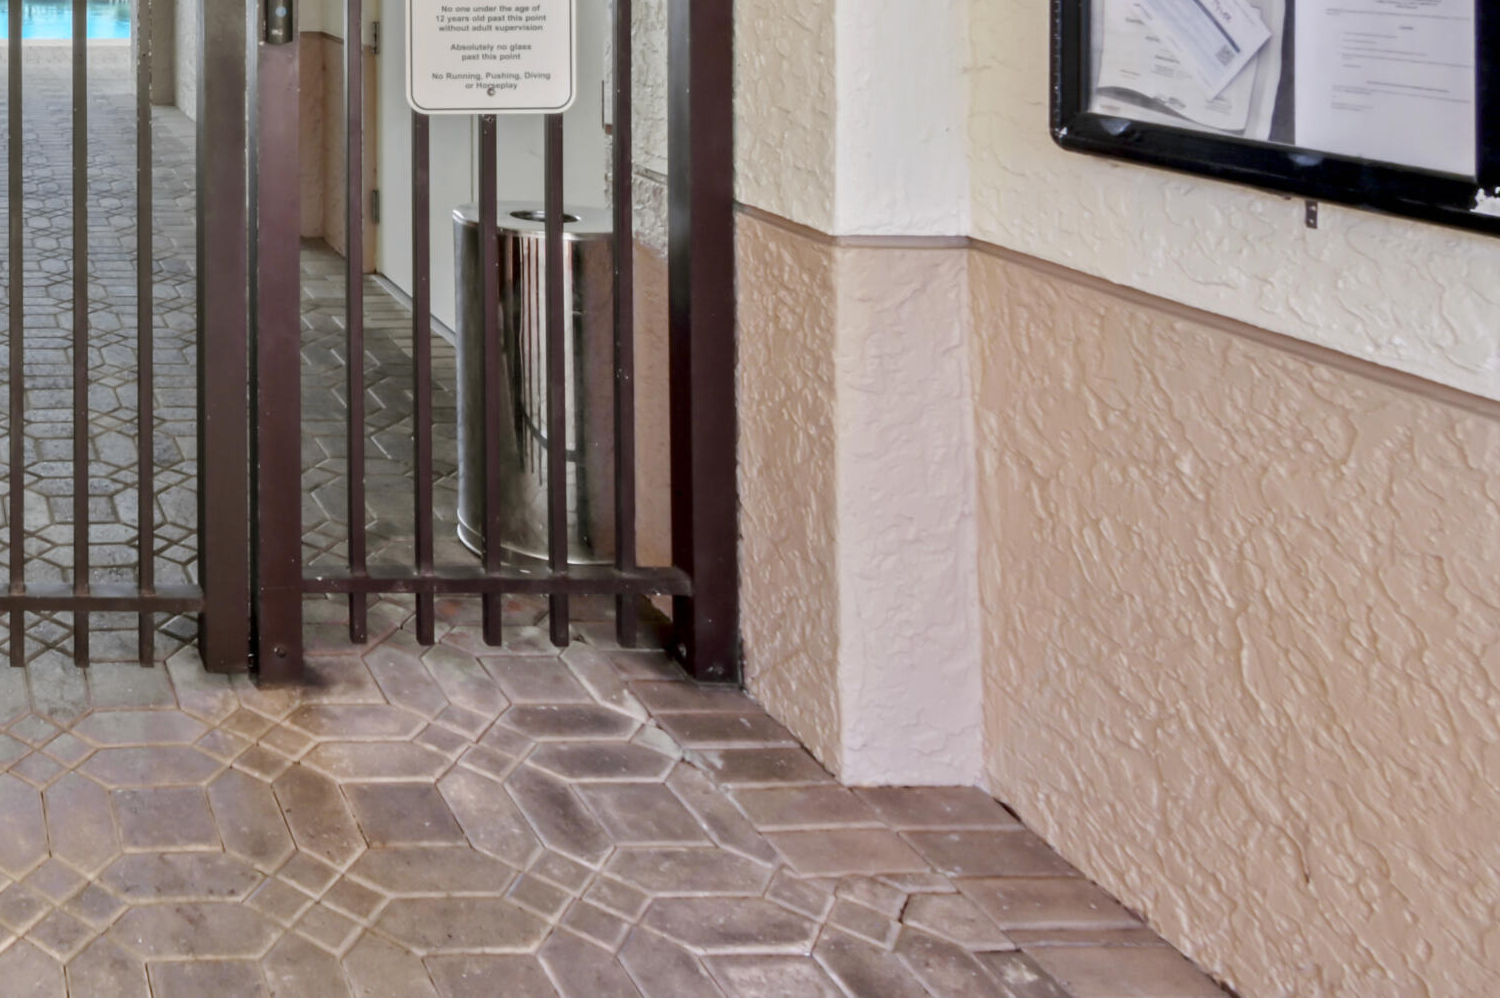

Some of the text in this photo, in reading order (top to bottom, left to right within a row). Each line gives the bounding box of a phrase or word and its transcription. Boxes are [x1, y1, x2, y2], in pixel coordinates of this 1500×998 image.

[514, 6, 529, 14] age
[447, 16, 469, 24] years
[487, 15, 505, 23] past
[525, 14, 546, 23] point
[495, 24, 543, 33] supervision
[450, 44, 494, 52] Absolutely
[510, 44, 532, 52] glass
[461, 54, 479, 62] past
[499, 53, 521, 62] point
[524, 72, 551, 80] Diving
[476, 82, 518, 90] Horseplay
